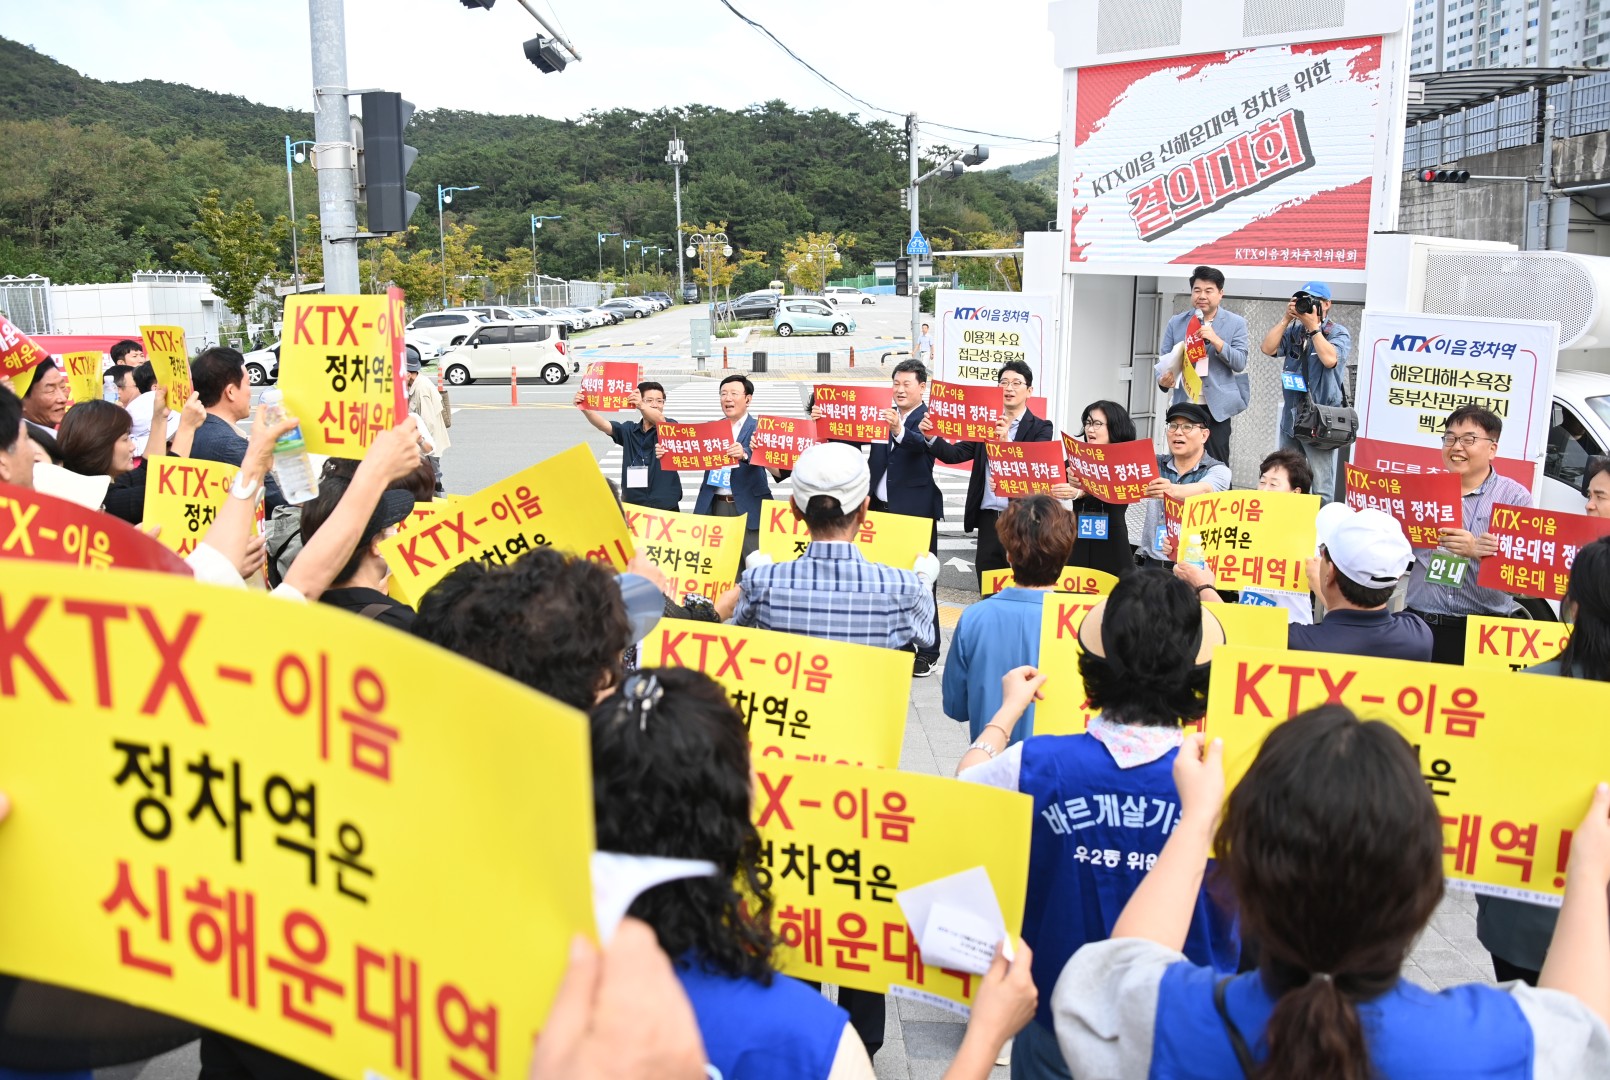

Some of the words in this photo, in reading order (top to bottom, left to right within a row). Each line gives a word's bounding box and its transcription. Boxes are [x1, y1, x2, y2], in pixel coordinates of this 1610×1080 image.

[1092, 150, 1156, 198] KTX이음
[1159, 107, 1239, 162] 신해운대역
[1241, 84, 1291, 121] 정차를
[1294, 58, 1332, 92] 위한
[1128, 110, 1311, 241] 결의대회
[963, 330, 995, 346] 이용객
[998, 333, 1020, 347] 수요
[325, 354, 394, 393] 정차역은
[607, 378, 633, 394] 정차로
[1283, 374, 1305, 390] 진행
[1390, 363, 1512, 393] 해운대해수욕장
[816, 387, 857, 402] KTX-이음
[931, 382, 965, 400] KTX-이음
[820, 403, 857, 420] 신해운대역
[860, 405, 887, 421] 정차로
[929, 399, 966, 420] 신해운대역
[970, 405, 998, 422] 정차로
[658, 424, 697, 438] KTX-이음
[757, 417, 795, 433] KTX-이음
[829, 422, 853, 437] 해운대
[937, 420, 962, 436] 해운대
[661, 438, 701, 454] 신해운대역
[703, 438, 730, 453] 정차로
[756, 432, 794, 451] 신해운대역
[797, 437, 822, 453] 정차
[985, 442, 1024, 458] KTX-이음
[1063, 436, 1105, 461] KTX-이음
[672, 455, 700, 468] 해운대
[765, 450, 789, 466] 해운대
[988, 459, 1029, 477] 신해운대역
[1031, 462, 1061, 479] 정차로
[1068, 454, 1111, 481] 신해운대역
[1114, 463, 1153, 481] 정차로
[999, 480, 1029, 494] 해운대
[1081, 477, 1110, 499] 해운대
[1346, 467, 1402, 494] KTX-이음
[1187, 498, 1264, 528] KTX-이음
[1411, 500, 1455, 523] 정차로
[1492, 508, 1557, 536] KTX-이음
[0, 496, 114, 570] X-이음
[397, 485, 543, 577] KTX-이음
[625, 510, 724, 548] KTX-이음
[1080, 518, 1107, 537] 진행
[1200, 526, 1252, 551] 정차역은
[646, 545, 713, 575] 정차역은
[1429, 558, 1466, 584] 안내
[1500, 563, 1545, 592] 해운대
[660, 629, 833, 694] KTX-이음
[0, 592, 401, 783] KTX-이음
[1233, 662, 1485, 738] KTX-이음
[731, 690, 812, 740] 차역은
[755, 771, 916, 843] X-이음
[1041, 793, 1182, 836] 바르게살기
[112, 739, 375, 905] 정차역은
[1073, 845, 1121, 868] 우2동
[777, 904, 972, 1000] 해운대
